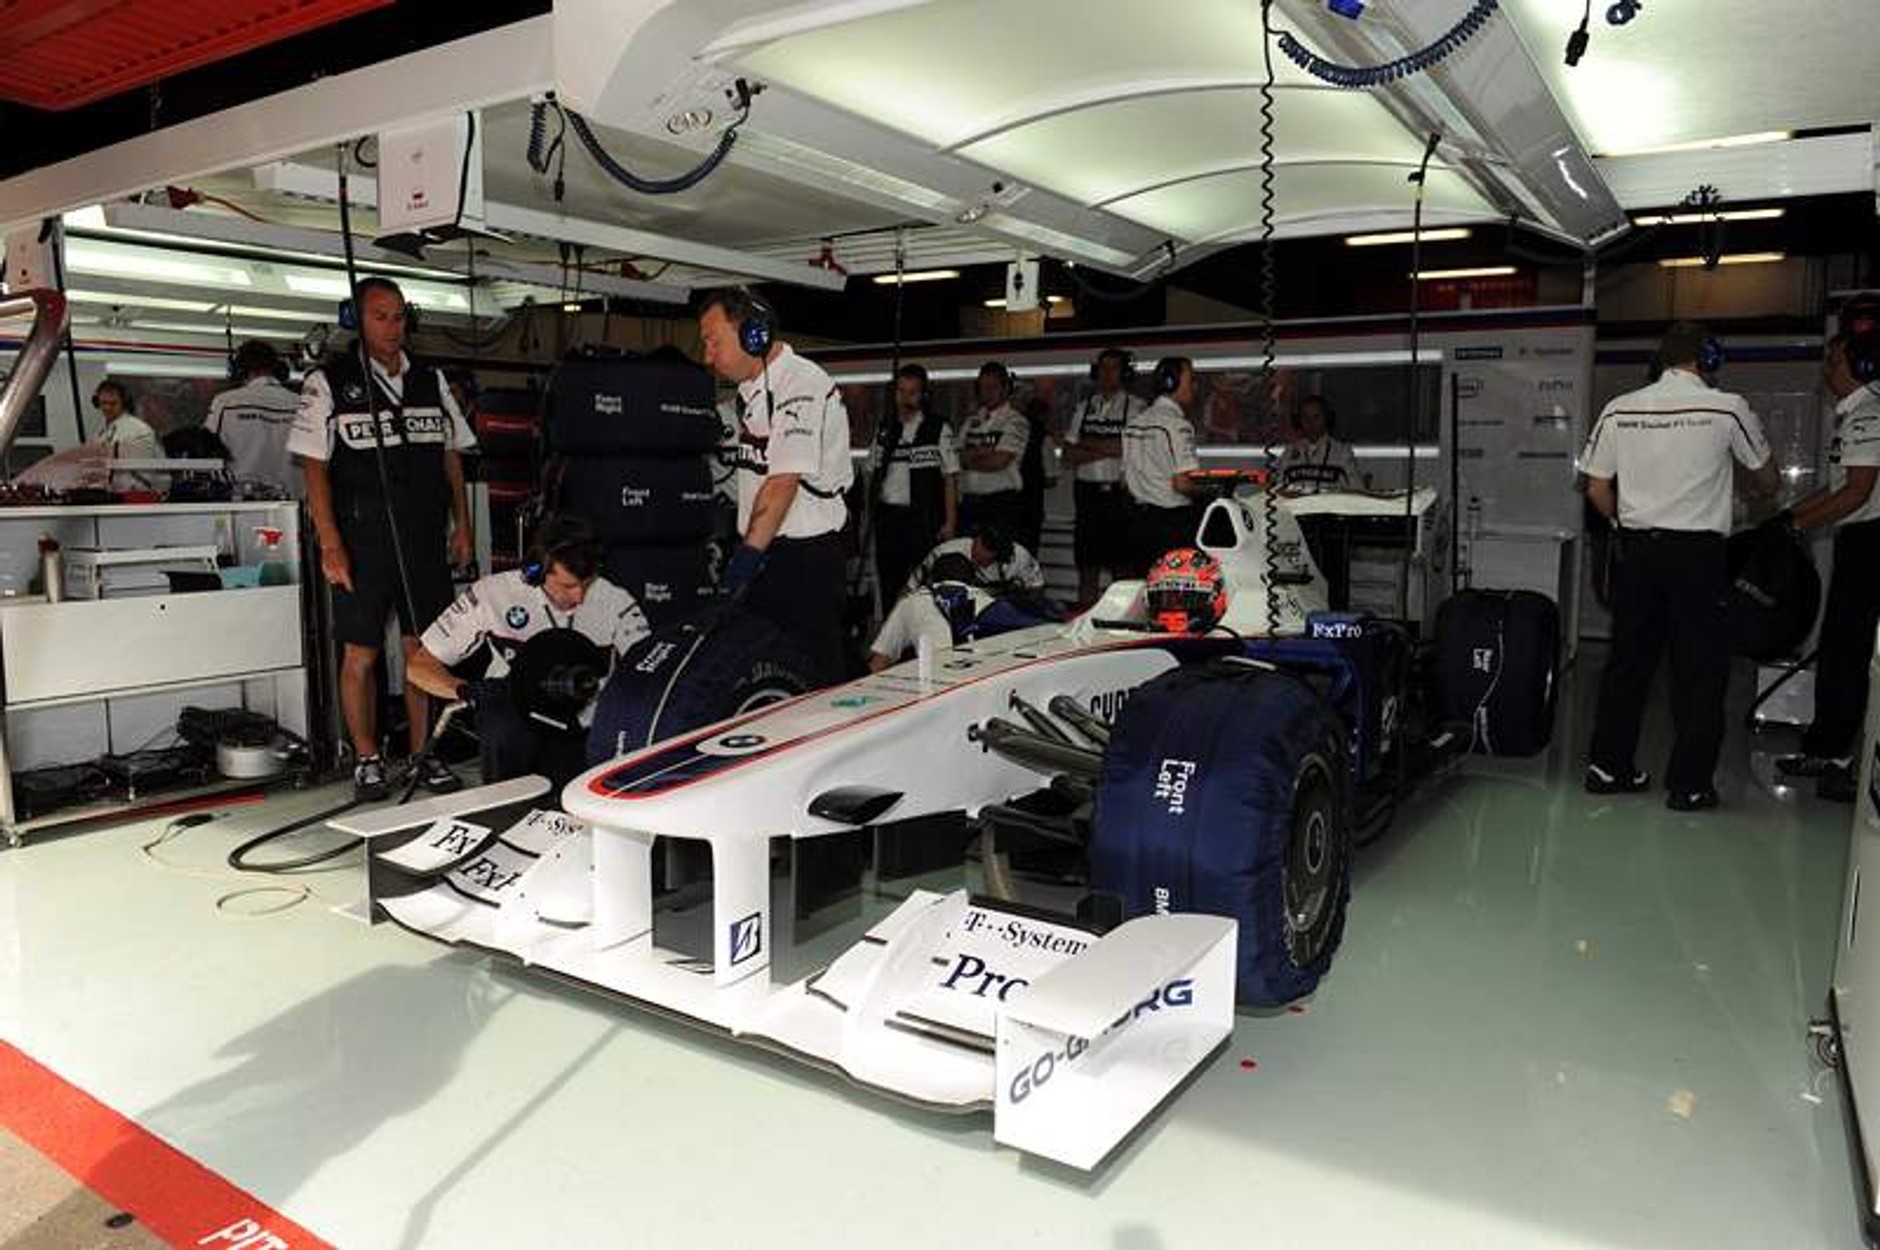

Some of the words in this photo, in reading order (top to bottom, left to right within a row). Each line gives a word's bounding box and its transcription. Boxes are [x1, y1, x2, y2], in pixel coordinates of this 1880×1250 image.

[1313, 622, 1362, 638] FxPro
[1153, 758, 1179, 801] Left
[1168, 760, 1196, 814] Front
